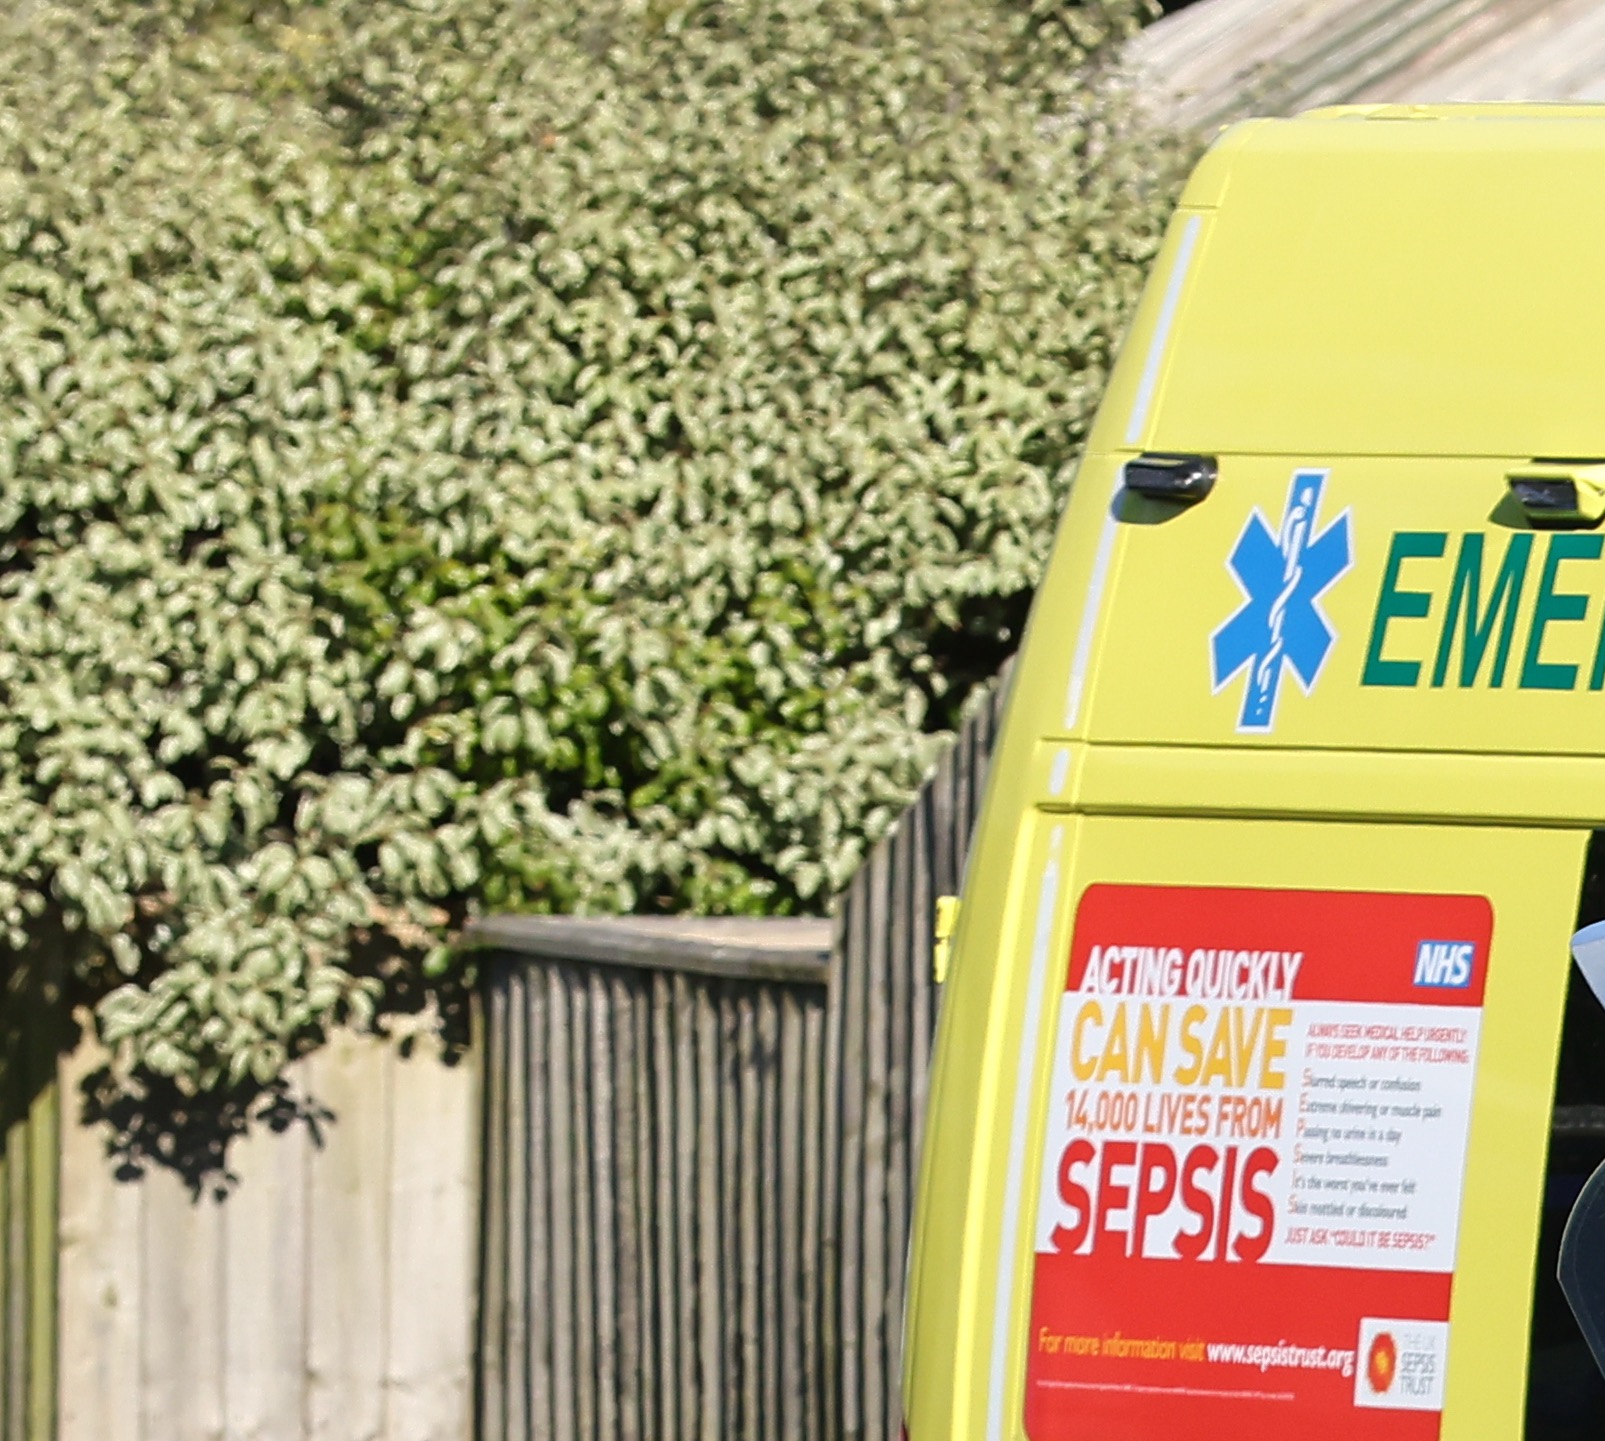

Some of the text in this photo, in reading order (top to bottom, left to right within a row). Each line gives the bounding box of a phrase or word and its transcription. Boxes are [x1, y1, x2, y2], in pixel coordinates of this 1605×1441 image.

[1078, 945, 1304, 1002] ACTING QUICKLY
[1415, 943, 1473, 985] NHS
[1070, 1000, 1294, 1089] CAN SAVE
[1066, 1088, 1284, 1139] 14,000 LIVES FROM
[1050, 1139, 1279, 1259] SEPSIS
[1039, 1325, 1355, 1378] For more information visit www.sepsistrust.org
